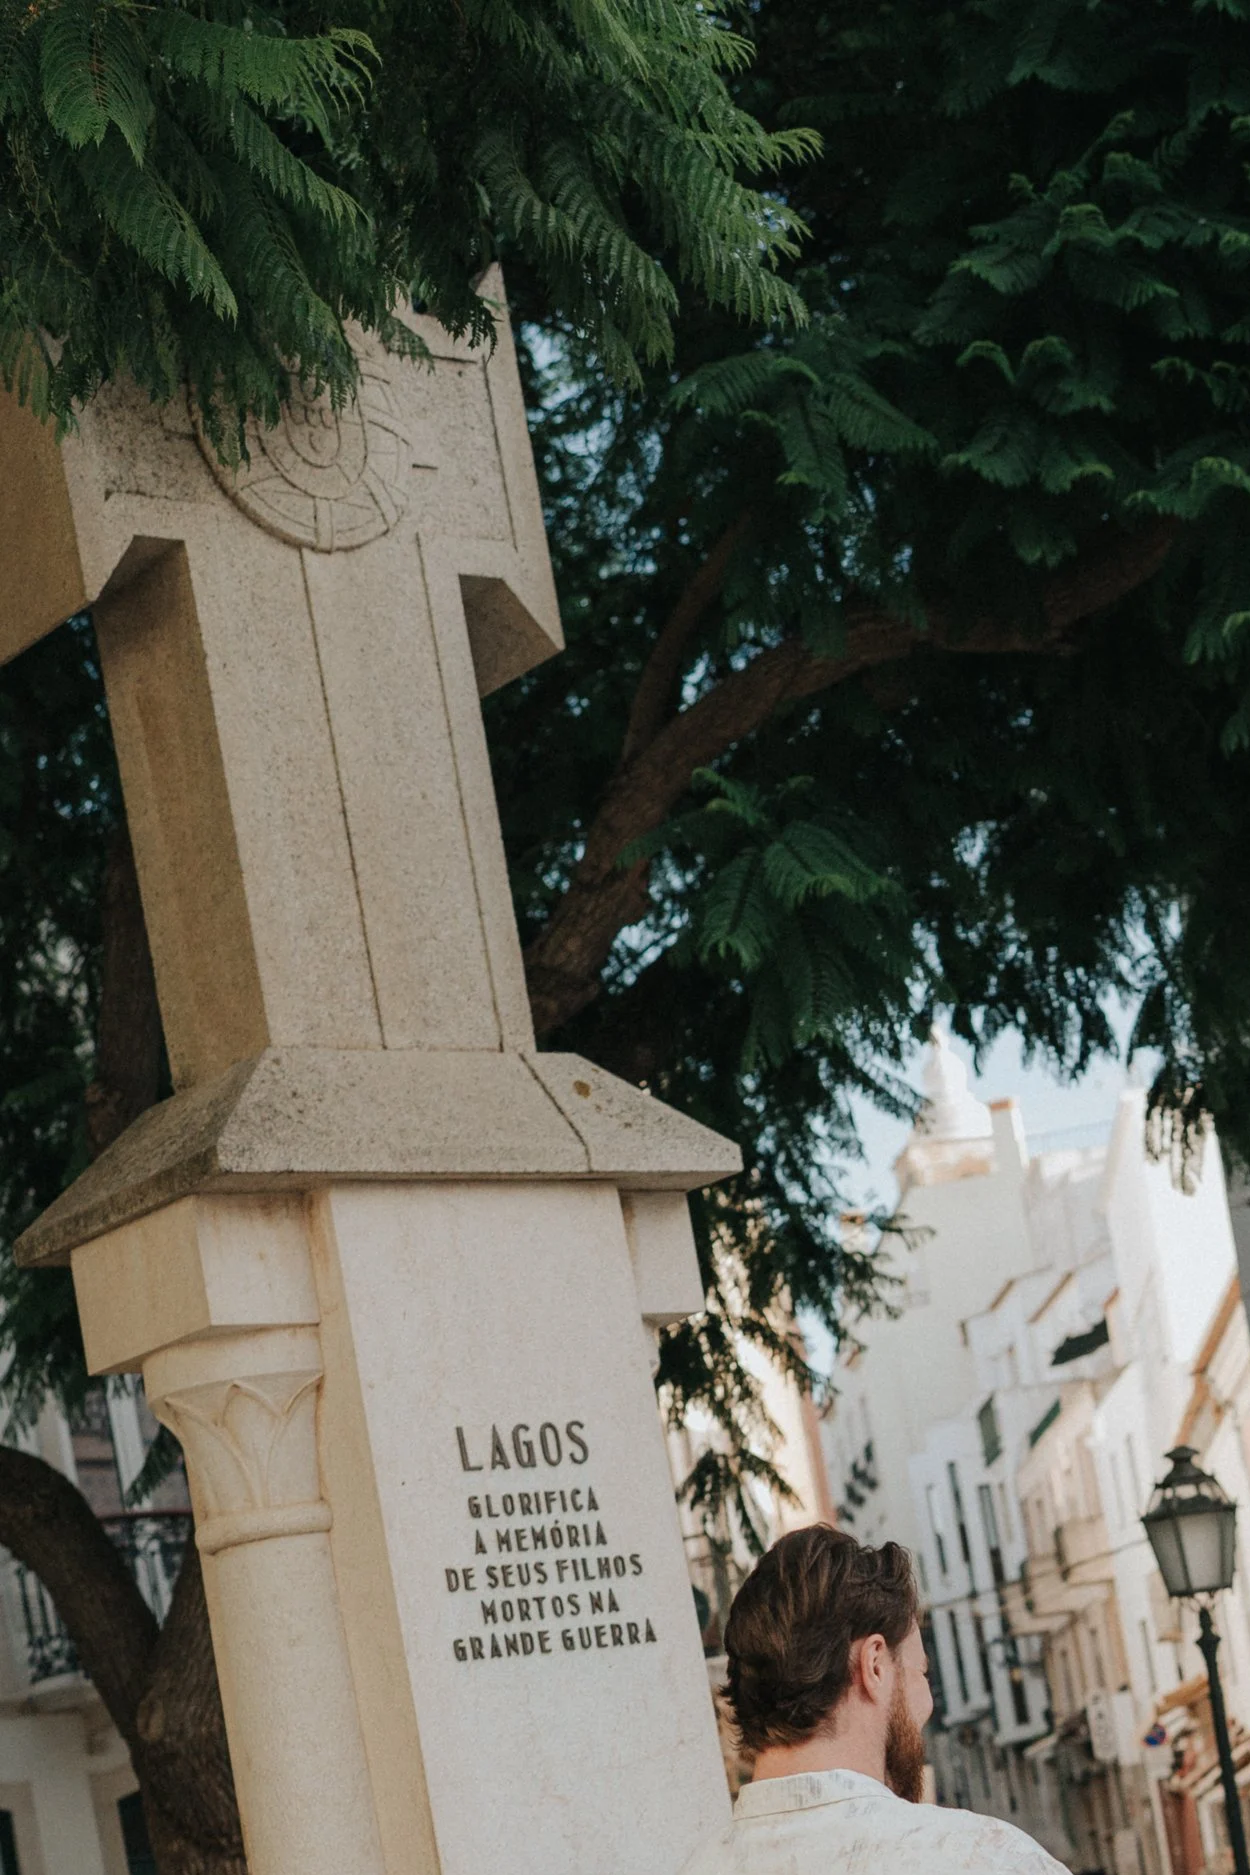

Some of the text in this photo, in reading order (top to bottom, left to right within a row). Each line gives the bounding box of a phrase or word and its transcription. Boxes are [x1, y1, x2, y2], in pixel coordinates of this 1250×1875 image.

[455, 1420, 590, 1472] LAGOS
[467, 1486, 600, 1519] GLORIFICA
[474, 1519, 608, 1555] A MEMÓRIA
[445, 1553, 644, 1593] DE SEUS FILHOS
[480, 1588, 620, 1626] MORTOS NA
[453, 1617, 658, 1662] GRANDE GUERRA
